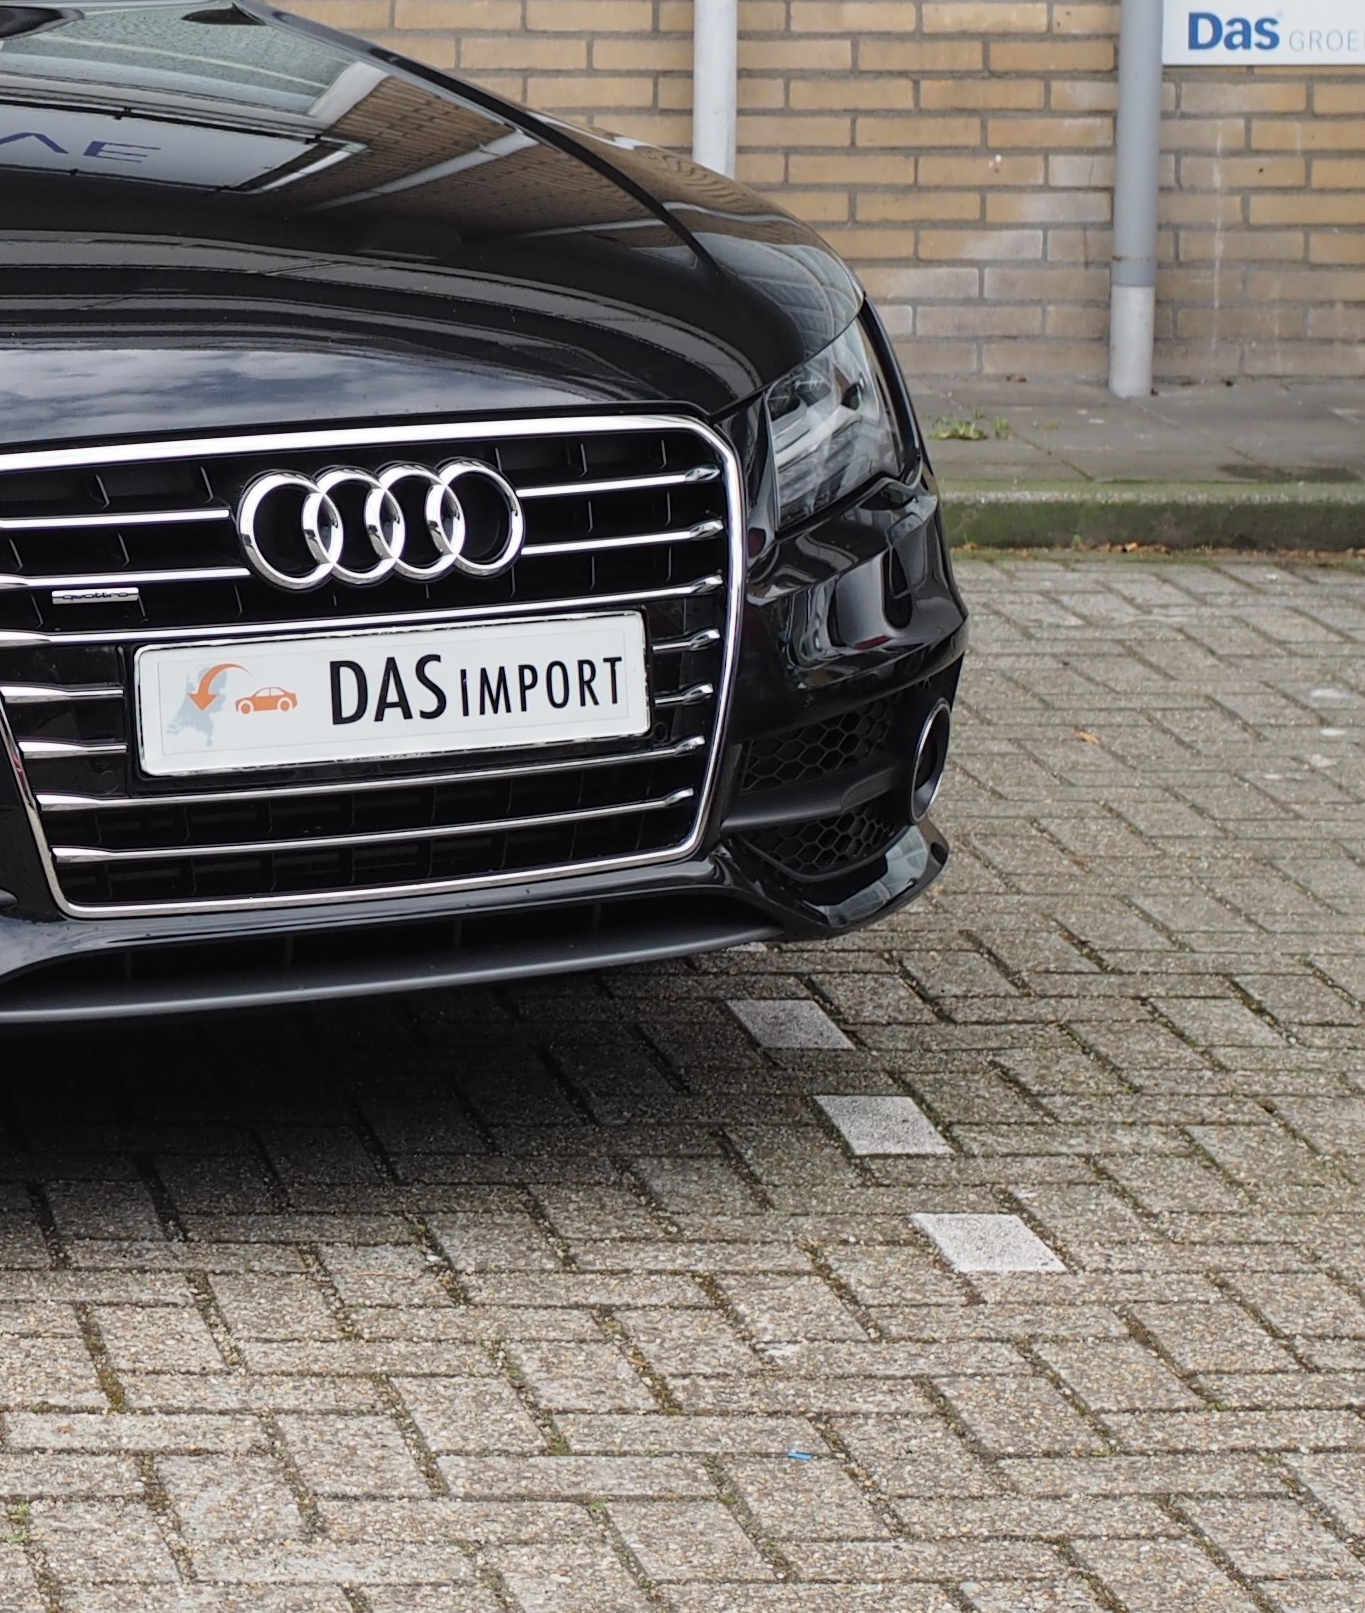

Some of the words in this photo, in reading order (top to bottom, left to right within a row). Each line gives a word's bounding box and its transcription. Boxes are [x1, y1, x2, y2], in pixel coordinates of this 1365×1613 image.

[1288, 29, 1365, 52] GROE
[329, 654, 447, 726] DAS
[459, 656, 623, 717] IMPORT
